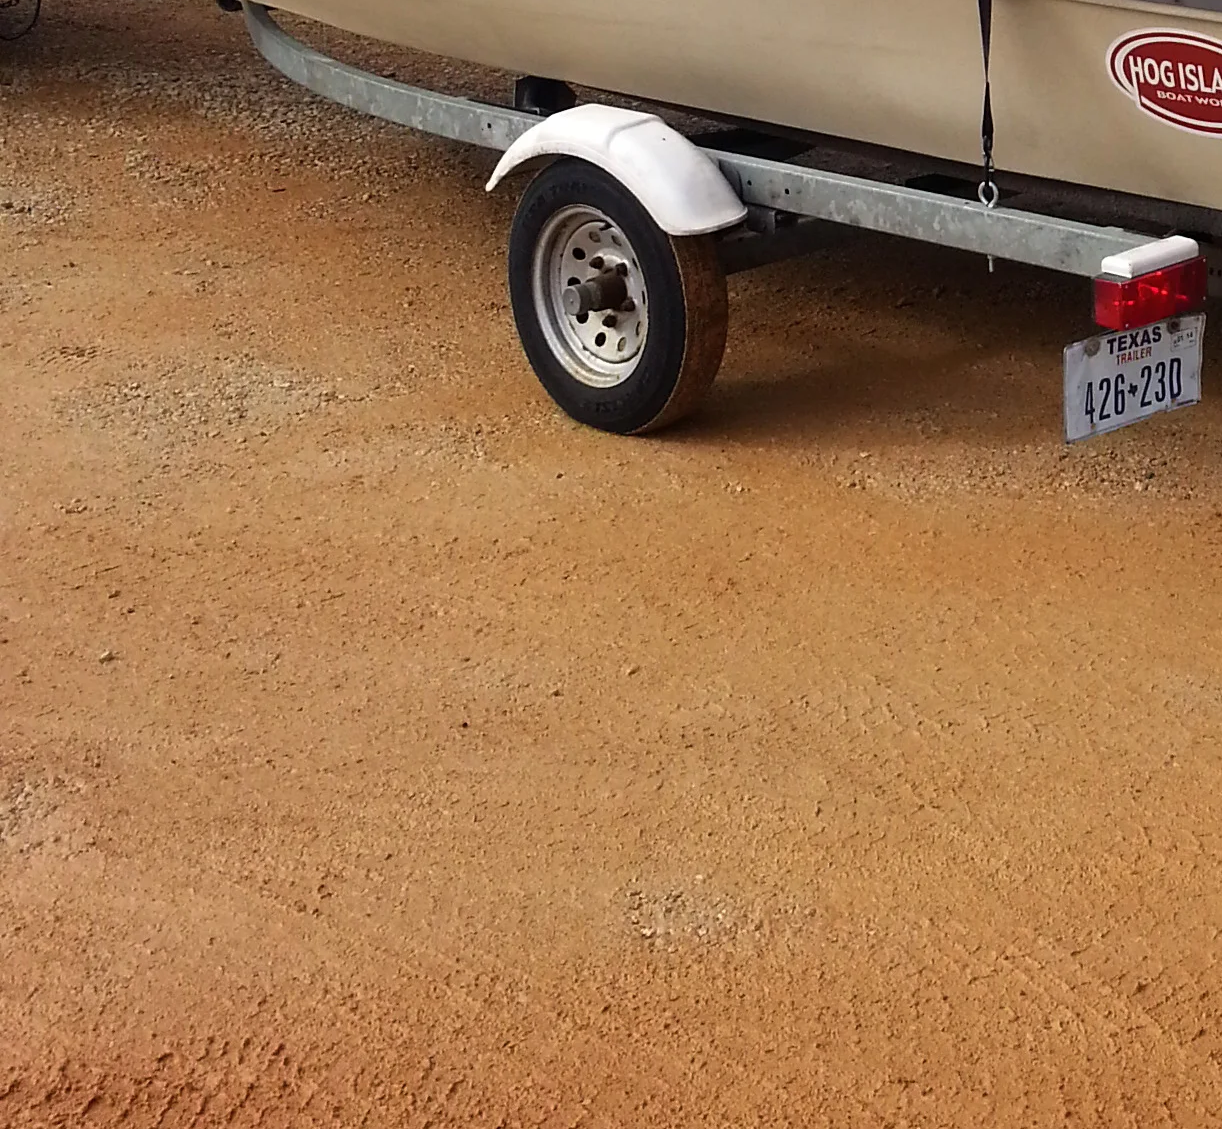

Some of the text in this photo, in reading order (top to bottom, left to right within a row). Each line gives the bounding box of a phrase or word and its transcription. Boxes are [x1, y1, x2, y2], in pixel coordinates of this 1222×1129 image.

[1128, 55, 1175, 89] HOG
[1156, 90, 1193, 104] BOAT
[1106, 326, 1162, 355] TEXAS
[1116, 346, 1153, 365] TRAILER
[1084, 373, 1126, 424] 426
